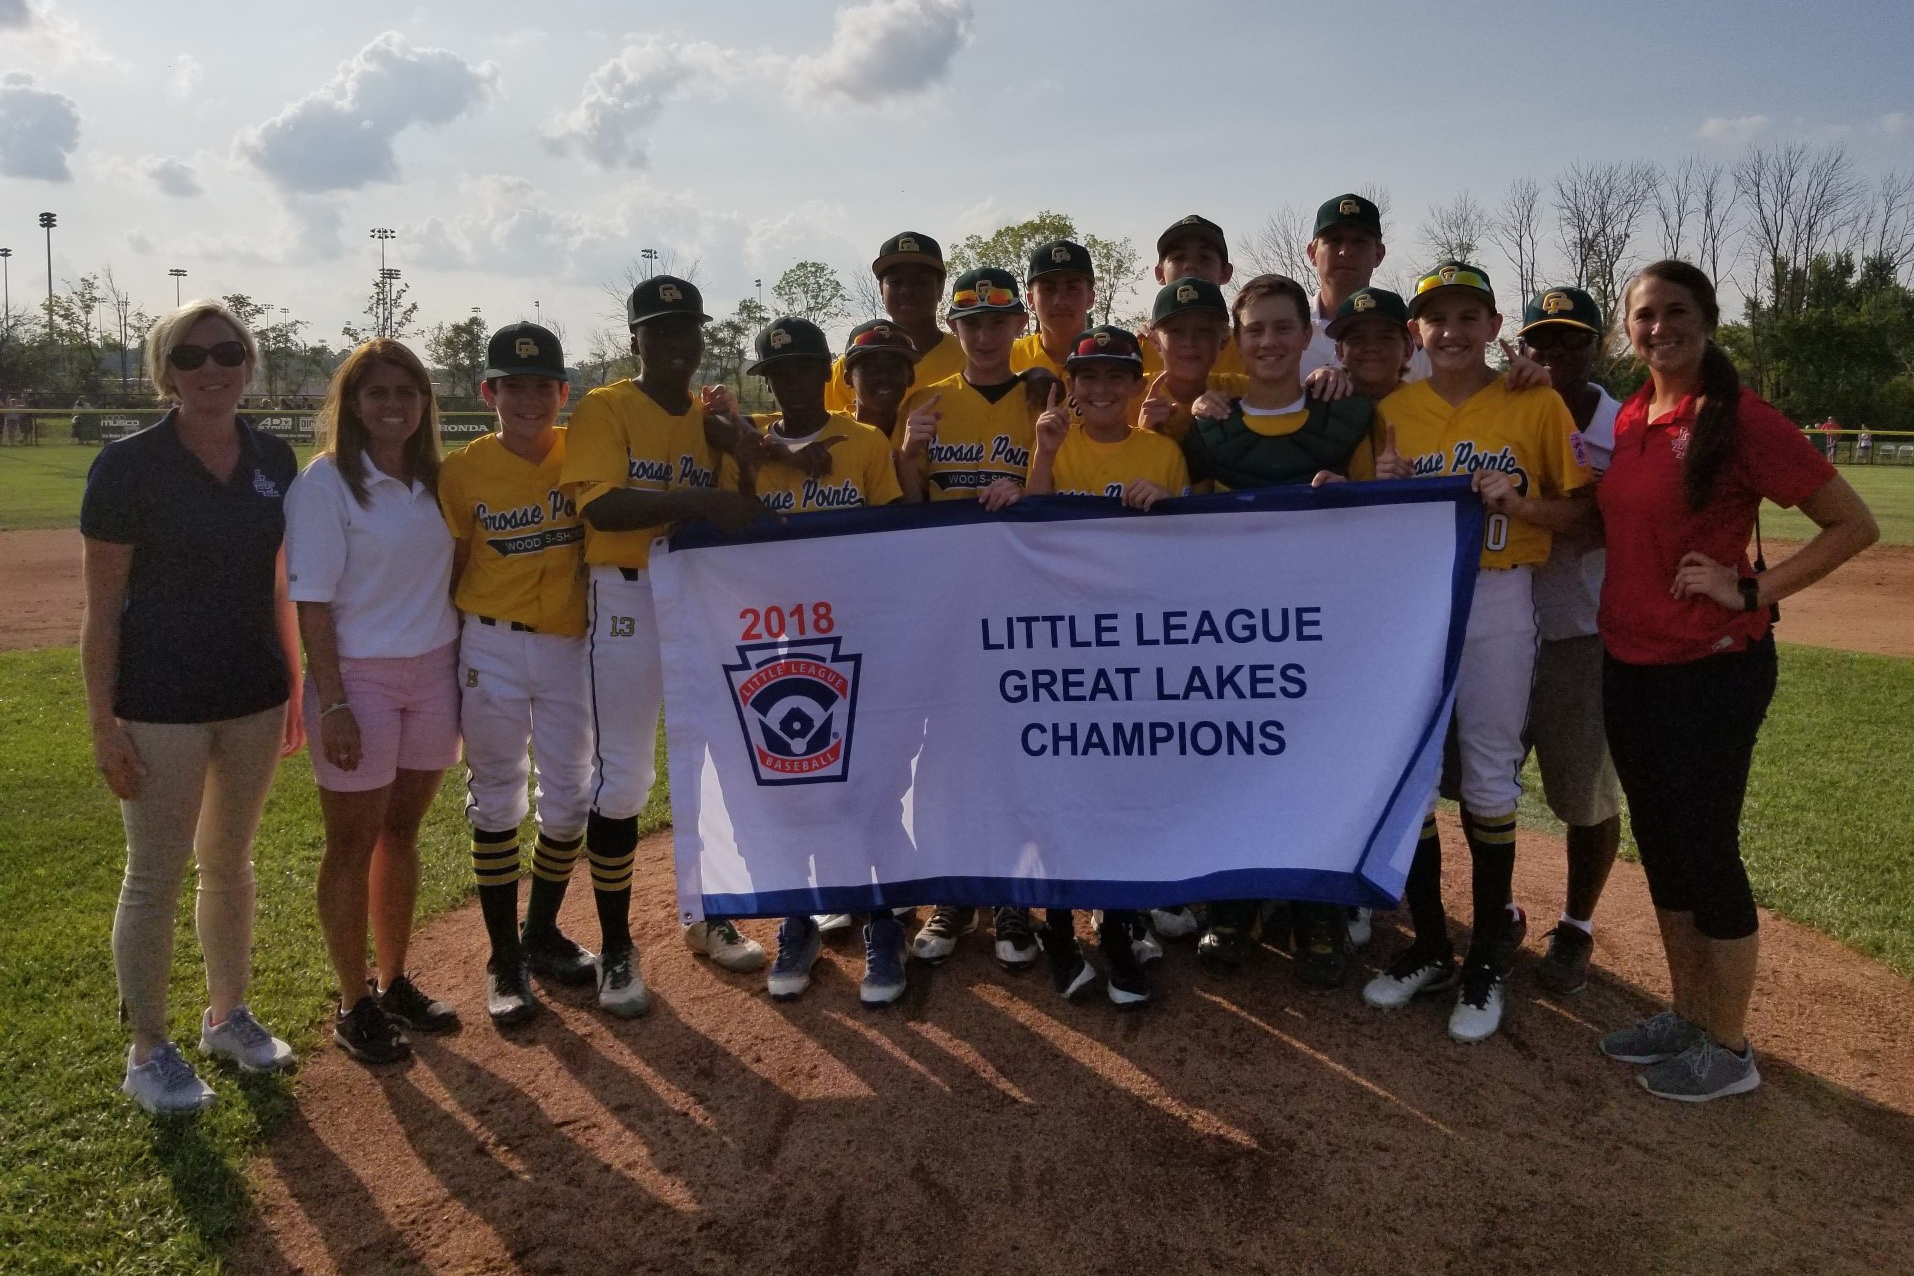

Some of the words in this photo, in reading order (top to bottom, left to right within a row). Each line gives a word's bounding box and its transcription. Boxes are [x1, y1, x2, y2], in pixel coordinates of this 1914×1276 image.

[439, 424, 489, 432] HONDA
[990, 435, 1030, 467] Poin
[801, 478, 865, 509] Pointe
[475, 502, 545, 532] Grosse
[610, 615, 635, 637] 13
[739, 601, 834, 641] 2018
[981, 613, 1120, 650] LITTLE
[1135, 606, 1323, 646] LEAGUE
[742, 666, 784, 697] LITTLE
[791, 663, 844, 690] LEAGUE
[999, 667, 1140, 704] GREAT
[1155, 663, 1307, 700] LAKES
[1021, 719, 1286, 757] CHAMPIONS
[765, 751, 835, 772] BASEBALL
